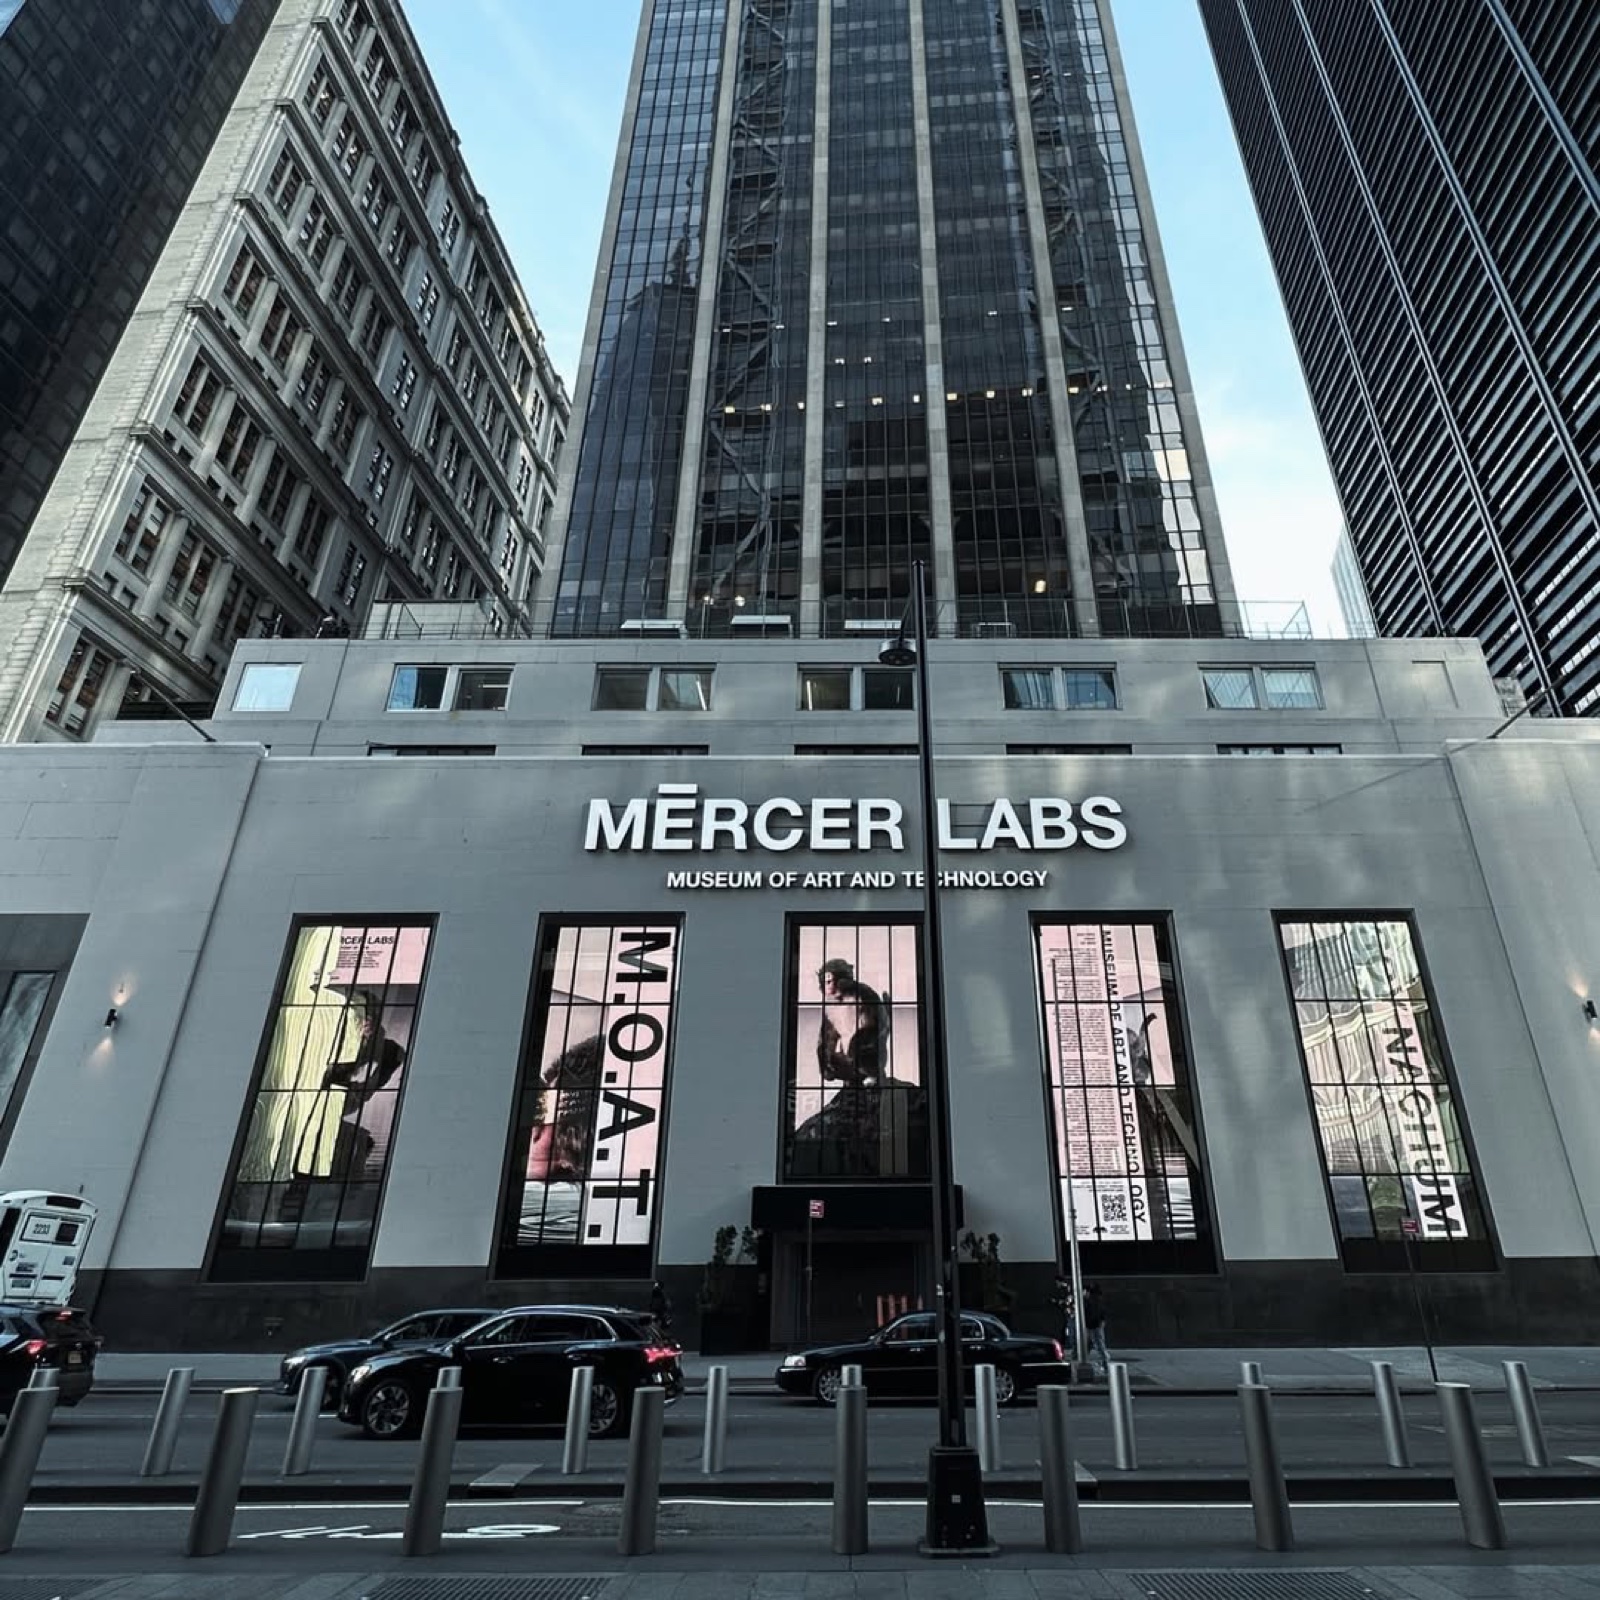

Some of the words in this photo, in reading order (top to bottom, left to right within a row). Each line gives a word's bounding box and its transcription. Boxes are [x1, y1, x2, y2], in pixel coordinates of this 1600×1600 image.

[583, 783, 904, 851] MĒRCER
[937, 796, 1128, 851] LABS
[666, 871, 762, 889] MUSEUM
[769, 871, 798, 888] OF
[803, 871, 845, 888] ART
[850, 870, 896, 888] AND
[1112, 1027, 1127, 1058] ART
[1116, 1063, 1130, 1097] AND
[1121, 1102, 1146, 1223] TECHNOOGY
